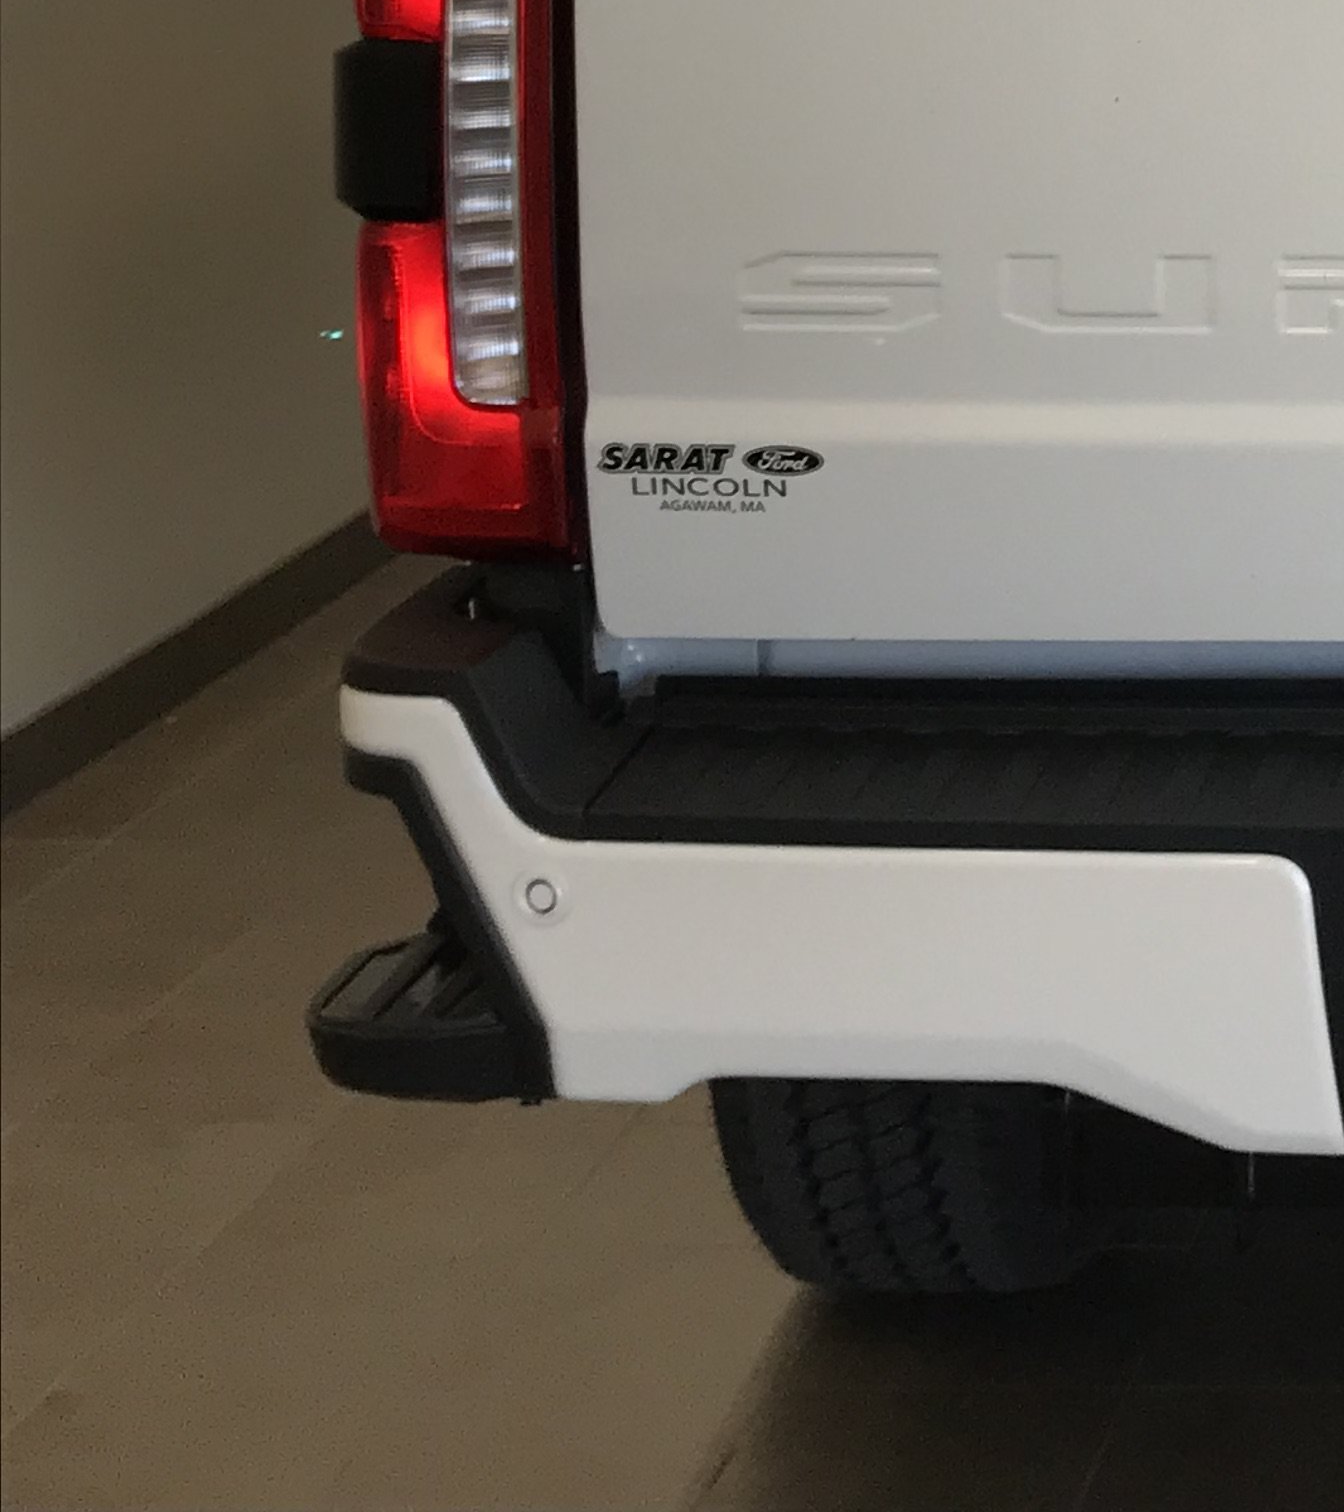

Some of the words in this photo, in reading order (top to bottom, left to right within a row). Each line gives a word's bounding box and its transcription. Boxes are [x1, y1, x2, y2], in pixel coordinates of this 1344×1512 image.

[599, 442, 736, 475] SARAT
[757, 450, 809, 472] Ford
[631, 476, 788, 498] LINCOLN
[659, 499, 737, 513] AGAWAM,
[740, 499, 767, 513] MA
